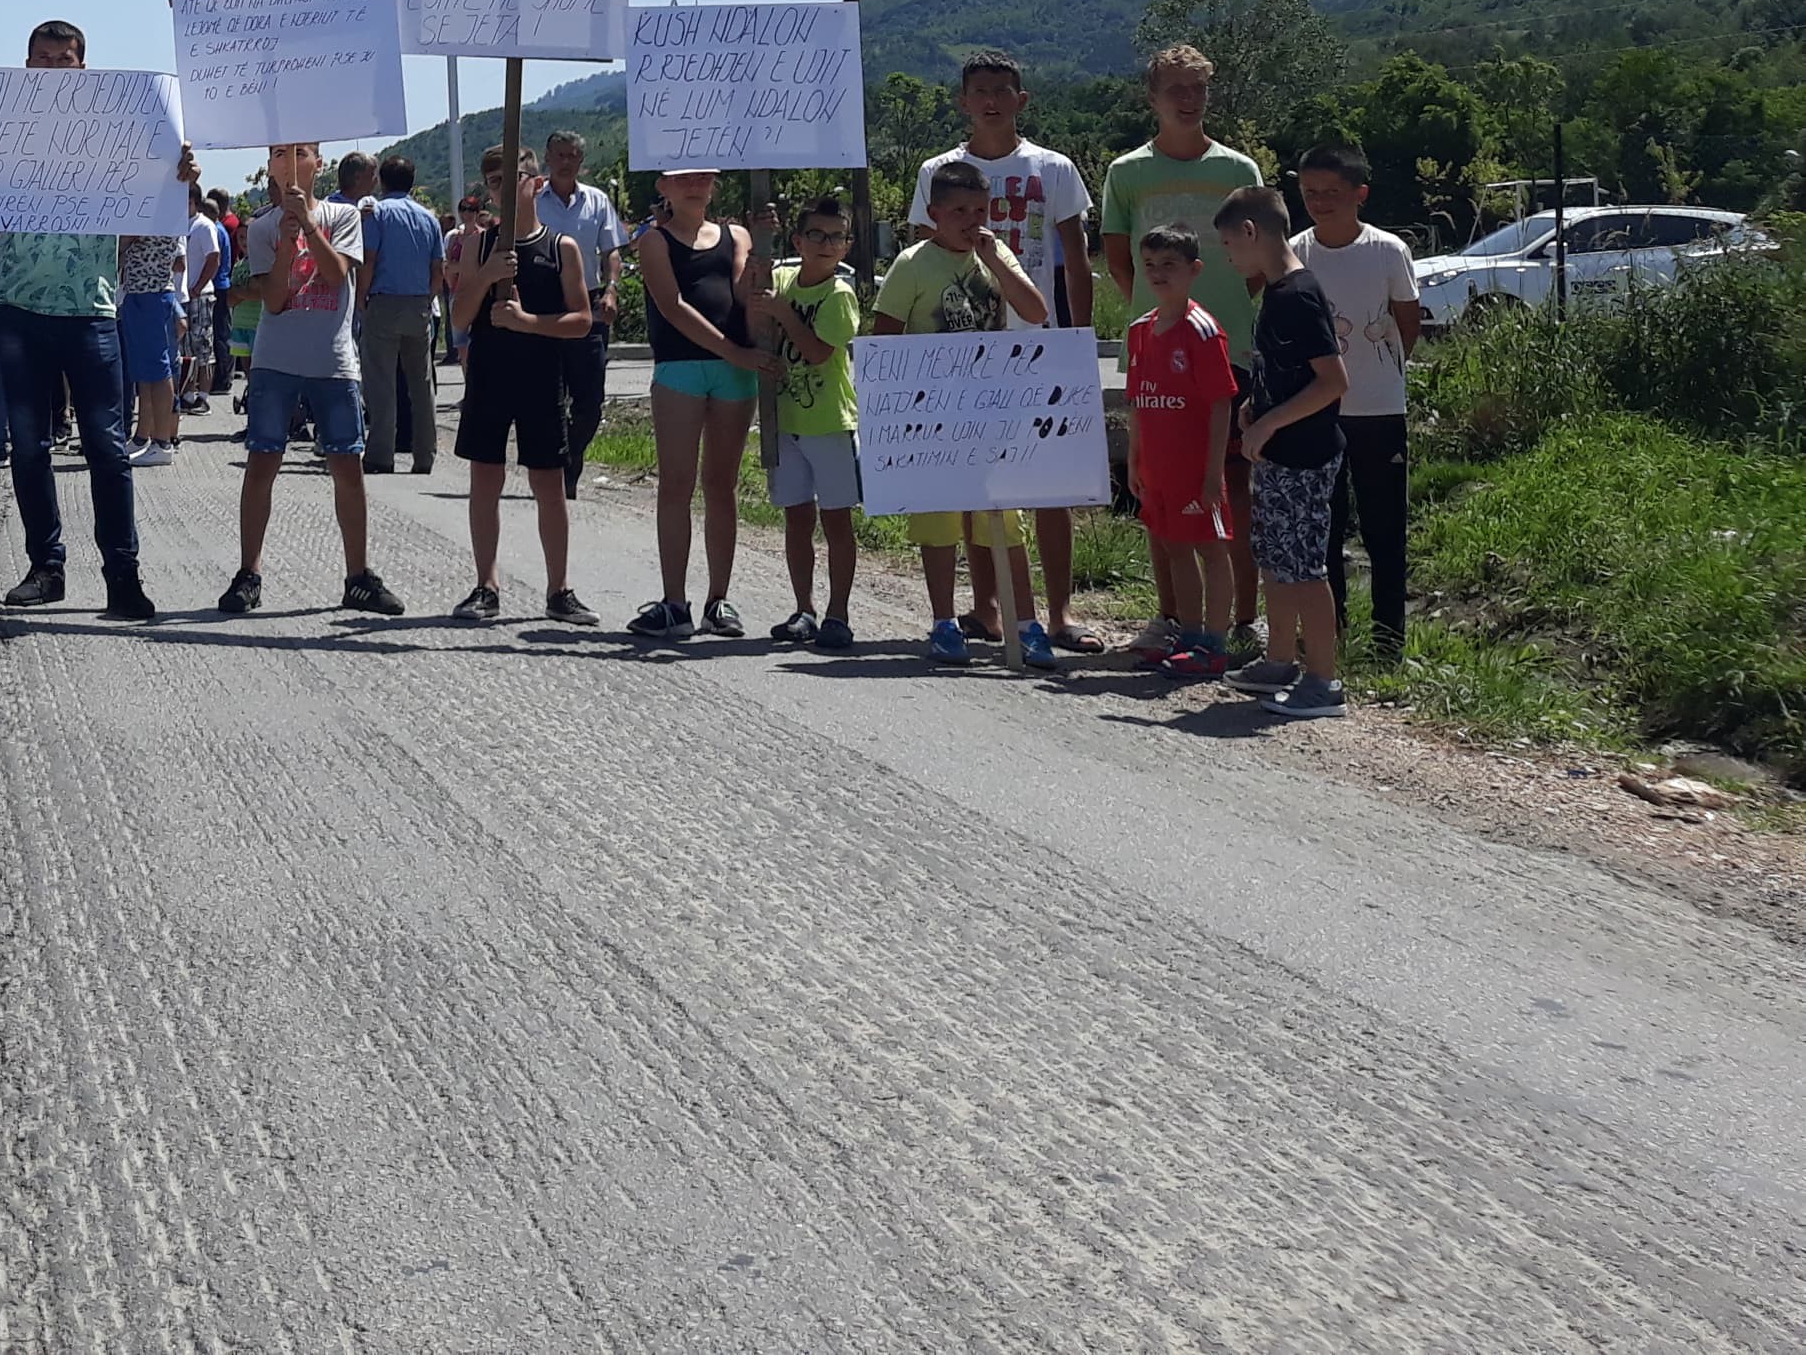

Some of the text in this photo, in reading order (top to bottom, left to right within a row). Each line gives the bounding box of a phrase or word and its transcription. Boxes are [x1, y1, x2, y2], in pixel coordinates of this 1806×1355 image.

[417, 14, 451, 45] SE
[458, 14, 520, 46] JETA
[633, 6, 820, 47] KUSH NDALON
[190, 43, 199, 57] E
[770, 50, 786, 83] E
[793, 48, 852, 85] UJIT
[225, 86, 233, 98] E
[680, 89, 735, 120] LUM
[743, 87, 847, 123] NDALON
[47, 119, 166, 160] NORMALE
[50, 195, 90, 215] PSE
[99, 196, 130, 218] PO
[137, 196, 155, 218] E
[861, 347, 910, 383] KENI
[956, 390, 967, 410] E
[1047, 385, 1094, 406] DUKE
[1135, 392, 1186, 409] irates
[878, 422, 944, 446] MARRUR
[995, 419, 1022, 442] JU
[1026, 415, 1053, 439] PO
[874, 447, 958, 472] SAKATIMIN
[966, 445, 979, 466] E
